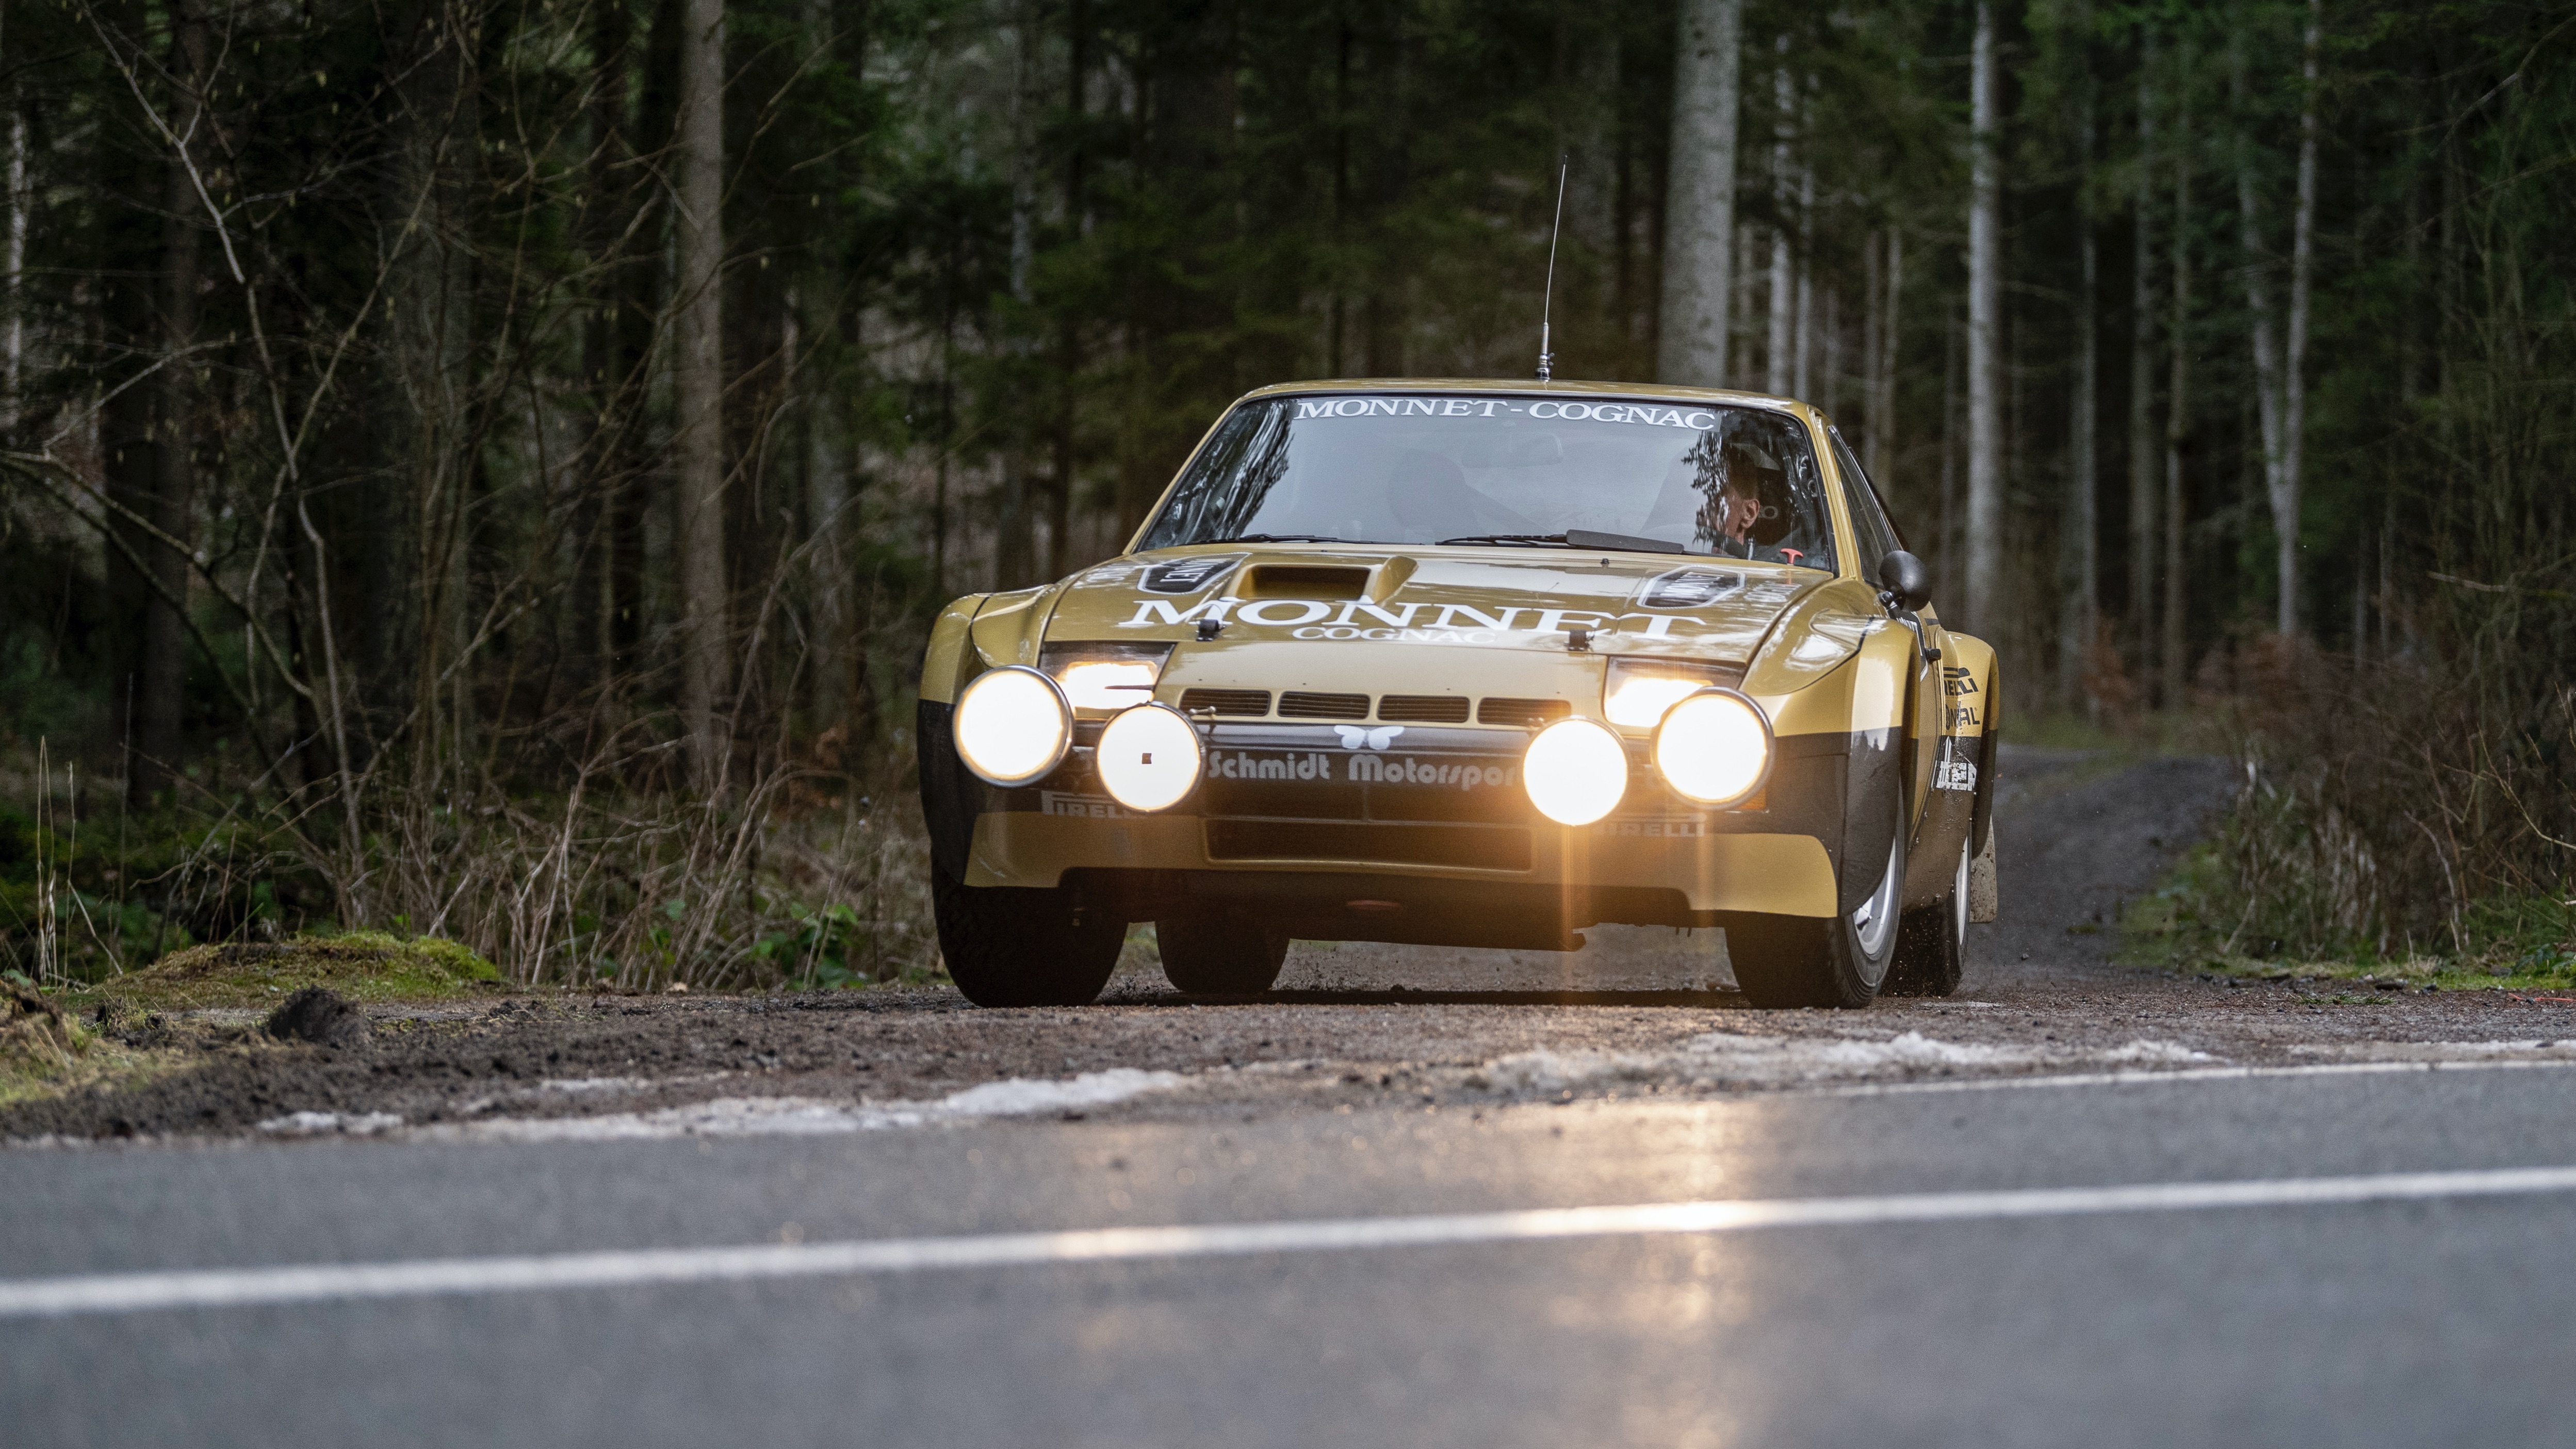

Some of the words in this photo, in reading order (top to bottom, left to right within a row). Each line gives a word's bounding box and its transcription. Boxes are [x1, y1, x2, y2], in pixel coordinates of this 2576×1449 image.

[1293, 399, 1716, 430] MONNET-COGNAC
[1118, 596, 1707, 641] MONNET
[1292, 626, 1496, 644] COGNAC
[1208, 751, 1330, 780] Schmidt
[1348, 754, 1520, 791] Motorspor
